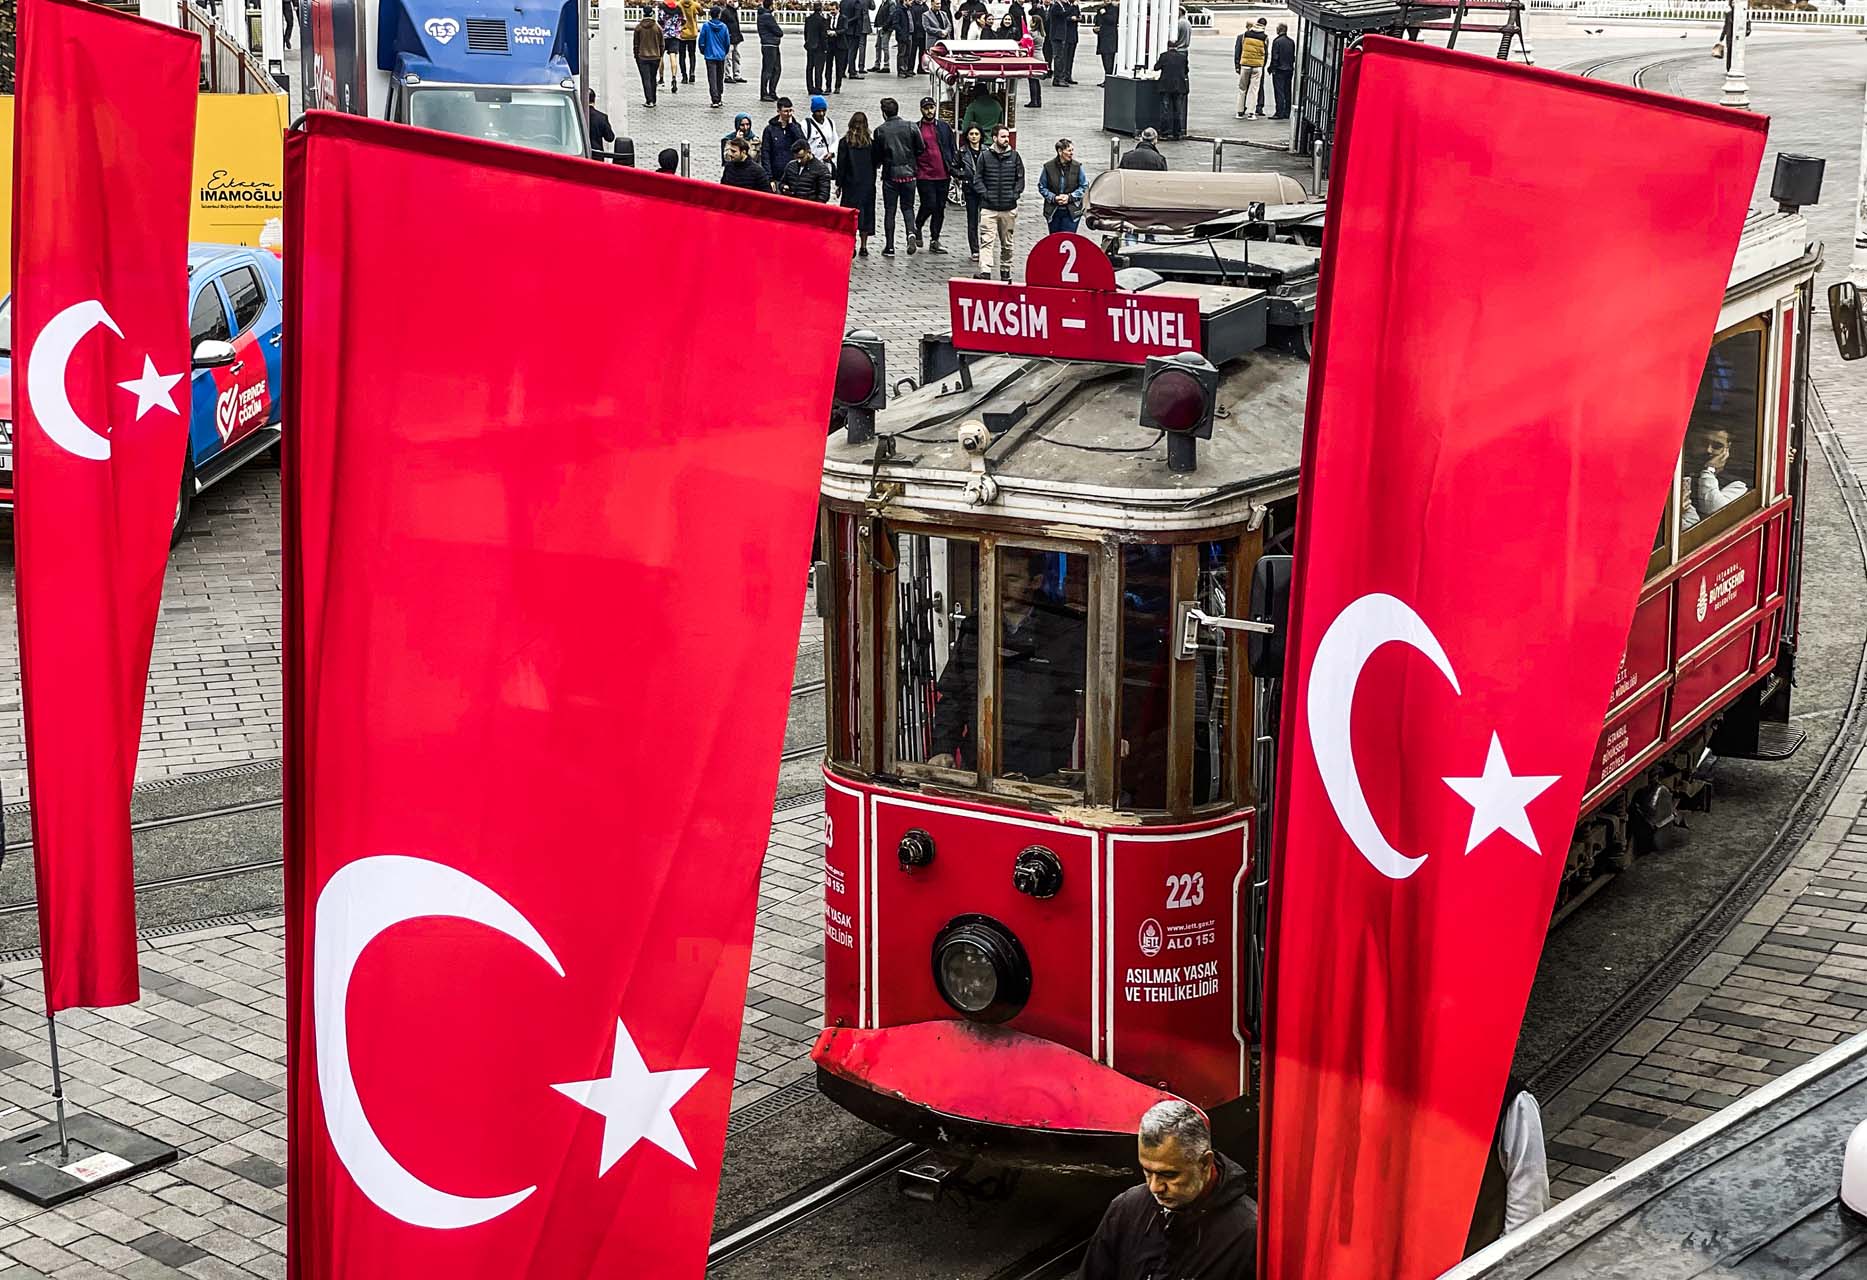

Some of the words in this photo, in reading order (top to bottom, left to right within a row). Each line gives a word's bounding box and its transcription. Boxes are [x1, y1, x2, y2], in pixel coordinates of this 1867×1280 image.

[430, 25, 456, 37] 153
[513, 26, 551, 37] ÇÖZÜM
[515, 36, 545, 45] HATTI
[200, 187, 282, 202] İMAMOĞLU
[1059, 240, 1079, 283] 2
[958, 294, 1049, 339] TAKSİM
[1107, 299, 1193, 348] TÜNEL
[239, 399, 262, 427] ÇÖZÜM
[832, 879, 845, 894] 153
[1166, 871, 1204, 909] 223
[831, 907, 852, 929] YASAK
[1166, 919, 1215, 932] www.iett.gov.tr
[1167, 937, 1192, 950] ALO
[1195, 932, 1215, 946] 153
[1126, 966, 1181, 984] ASILMAK
[1183, 960, 1218, 981] YASAK
[1125, 986, 1141, 1002] VE
[1143, 978, 1219, 1002] TEHLİKELİDİR
